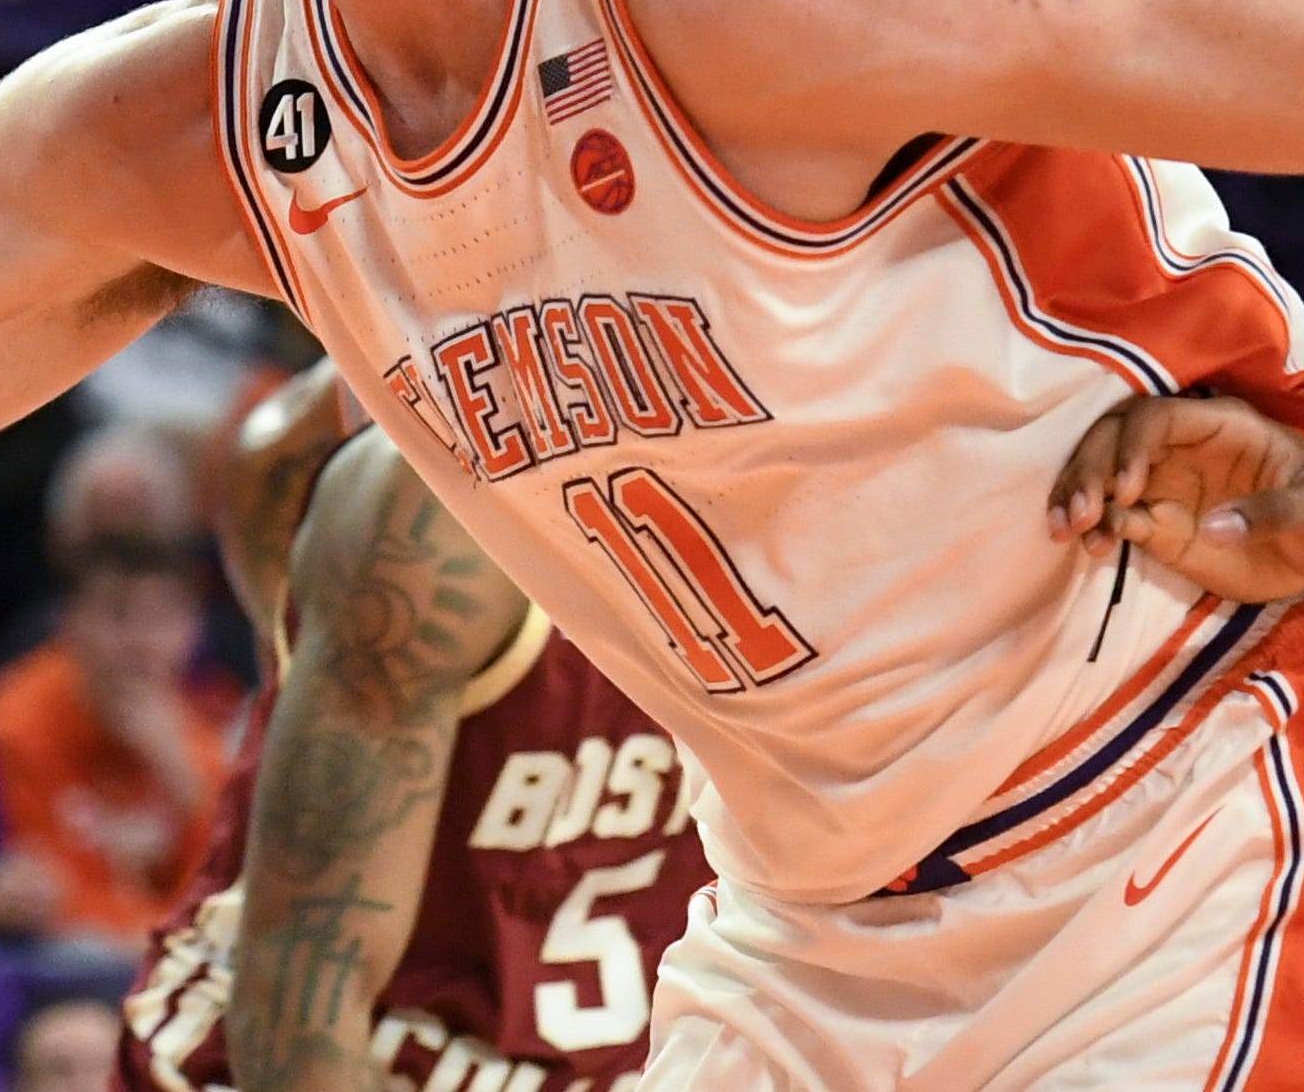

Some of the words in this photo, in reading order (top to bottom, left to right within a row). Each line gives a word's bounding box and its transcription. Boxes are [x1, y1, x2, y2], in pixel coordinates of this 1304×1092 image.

[266, 92, 315, 160] 41
[562, 466, 818, 694] 11
[534, 850, 665, 1052] 5
